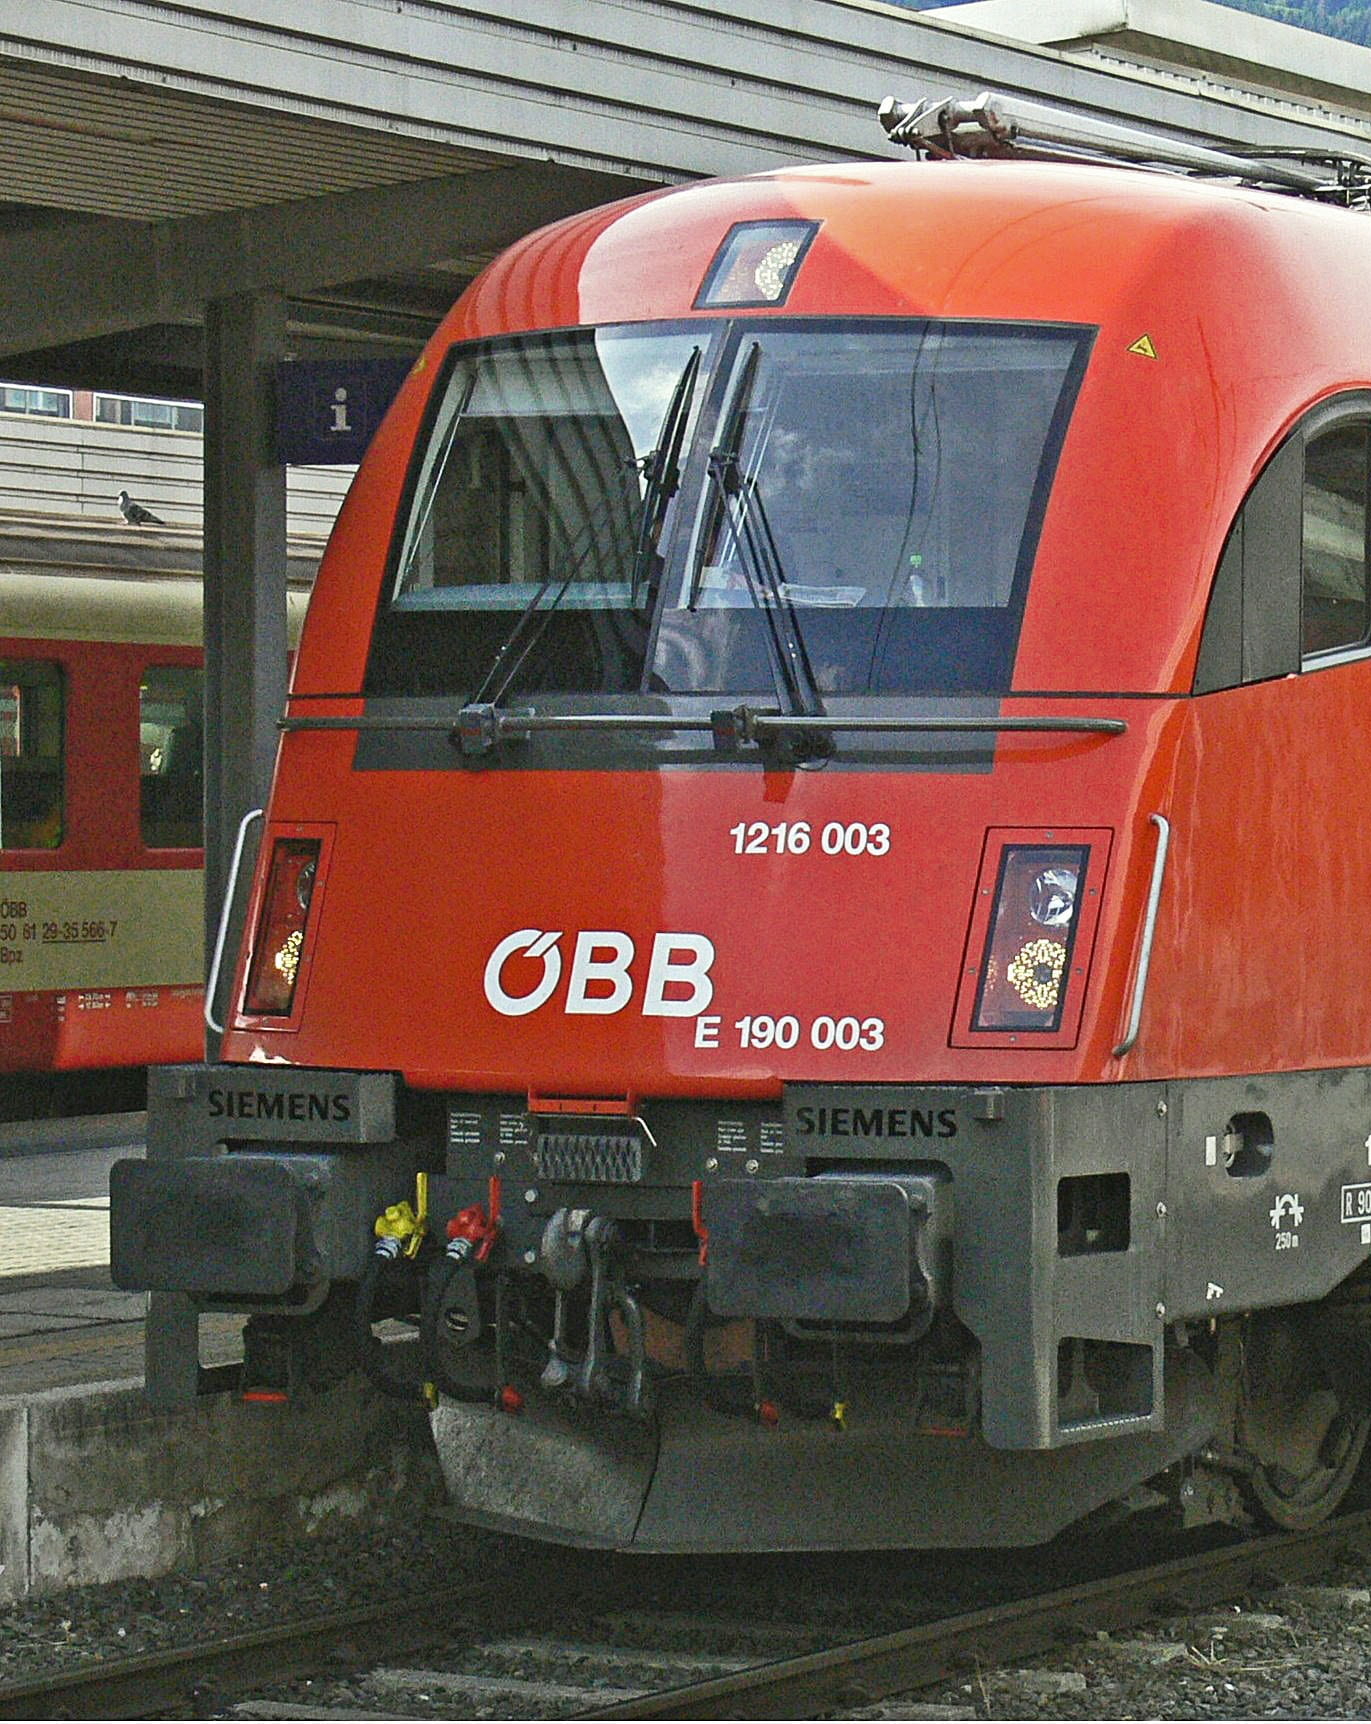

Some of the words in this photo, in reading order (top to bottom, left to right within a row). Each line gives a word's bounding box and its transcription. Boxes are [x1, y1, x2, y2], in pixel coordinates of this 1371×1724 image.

[729, 821, 812, 855] 1216
[821, 821, 891, 857] 003
[484, 928, 717, 1018] ÖBB
[694, 1015, 722, 1049] E
[734, 1014, 800, 1050] 190
[810, 1015, 885, 1052] 003
[207, 1089, 352, 1122] SIEMENS
[796, 1106, 958, 1139] SIEMENS
[1345, 1191, 1354, 1217] R
